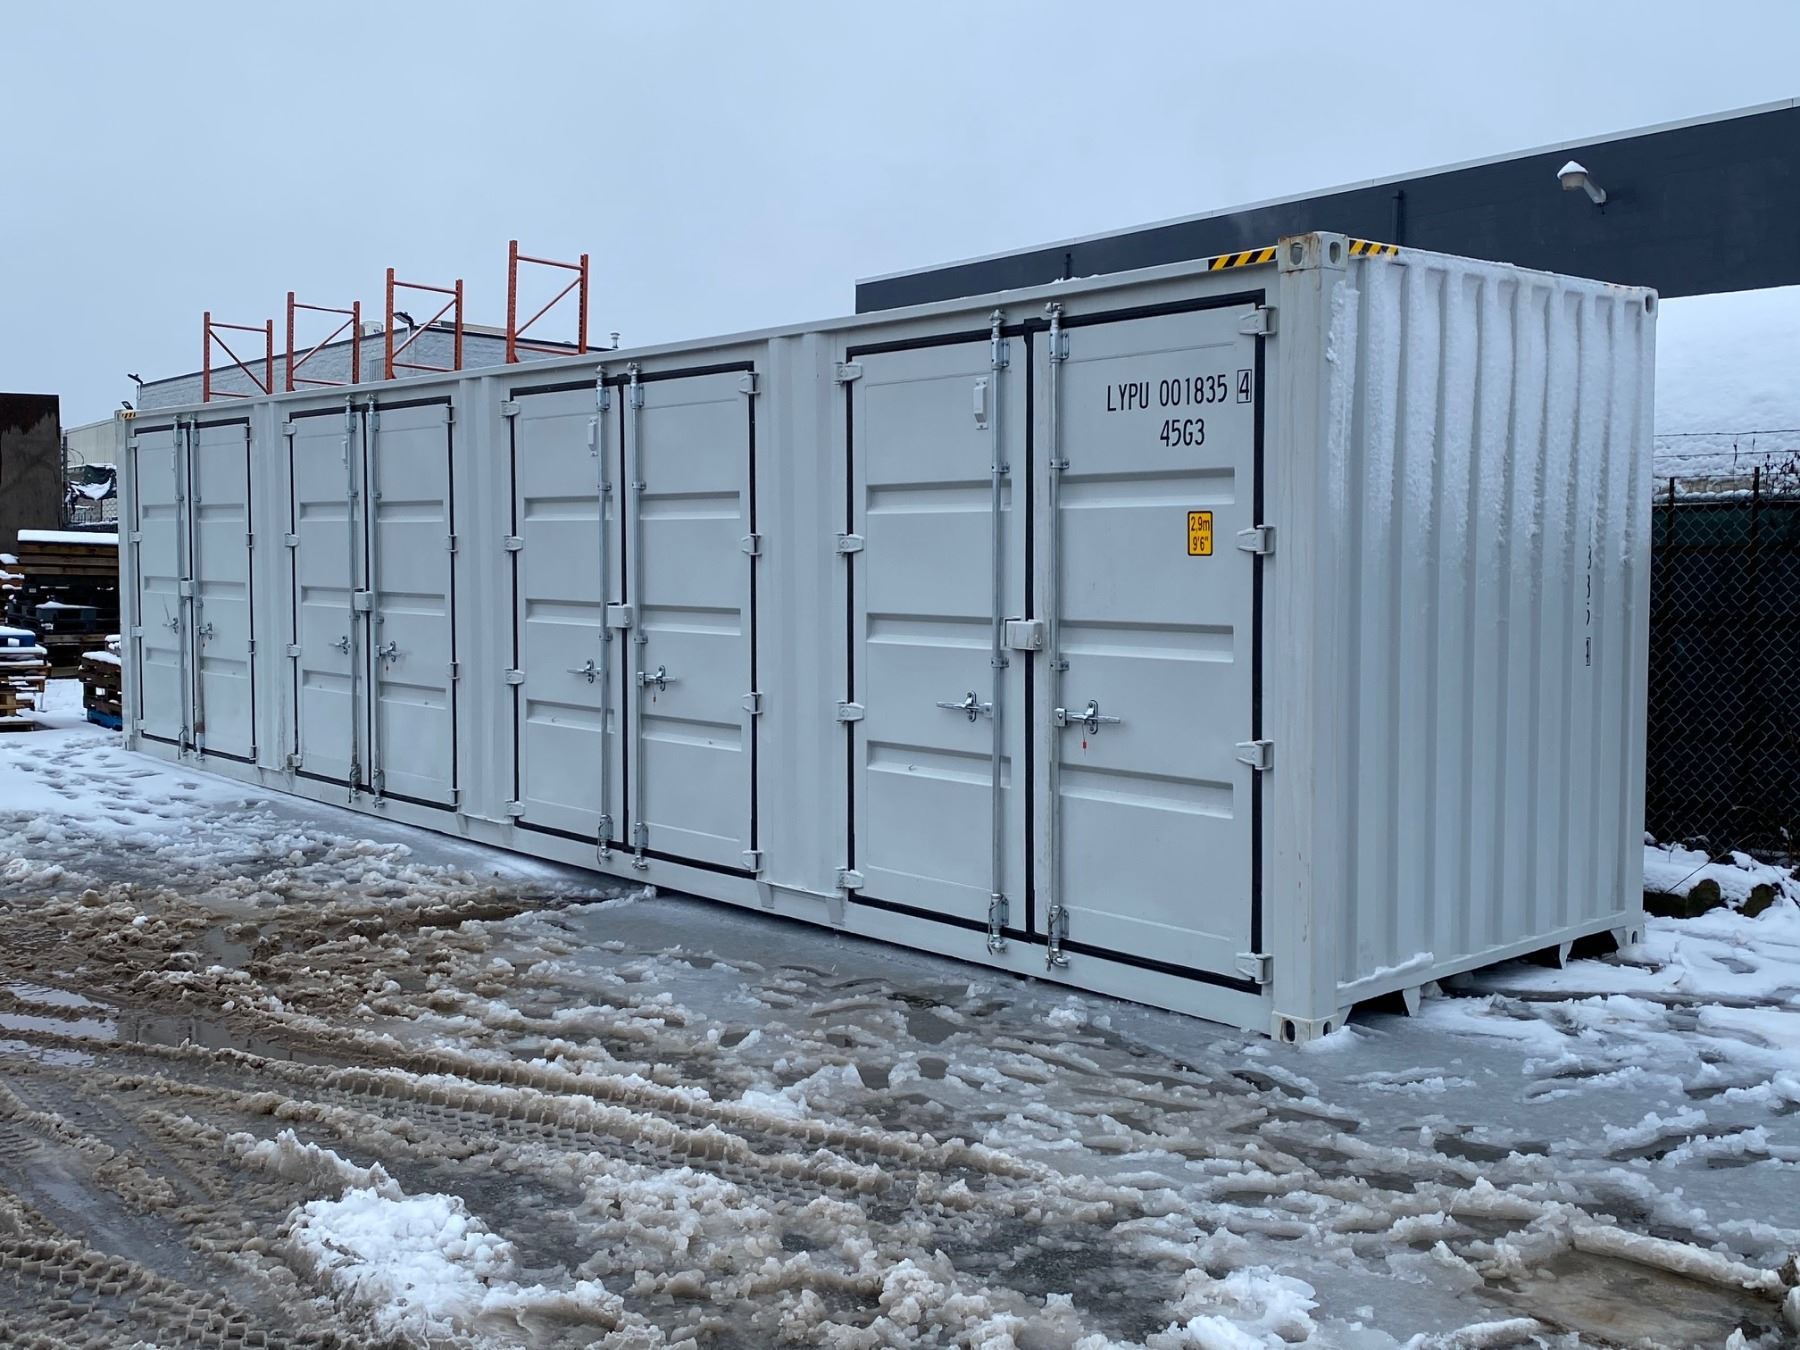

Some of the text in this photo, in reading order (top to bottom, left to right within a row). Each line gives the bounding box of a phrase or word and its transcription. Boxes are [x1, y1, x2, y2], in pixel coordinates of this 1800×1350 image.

[1107, 371, 1251, 412] LYPU 001835 4
[1159, 418, 1205, 447] 45G3
